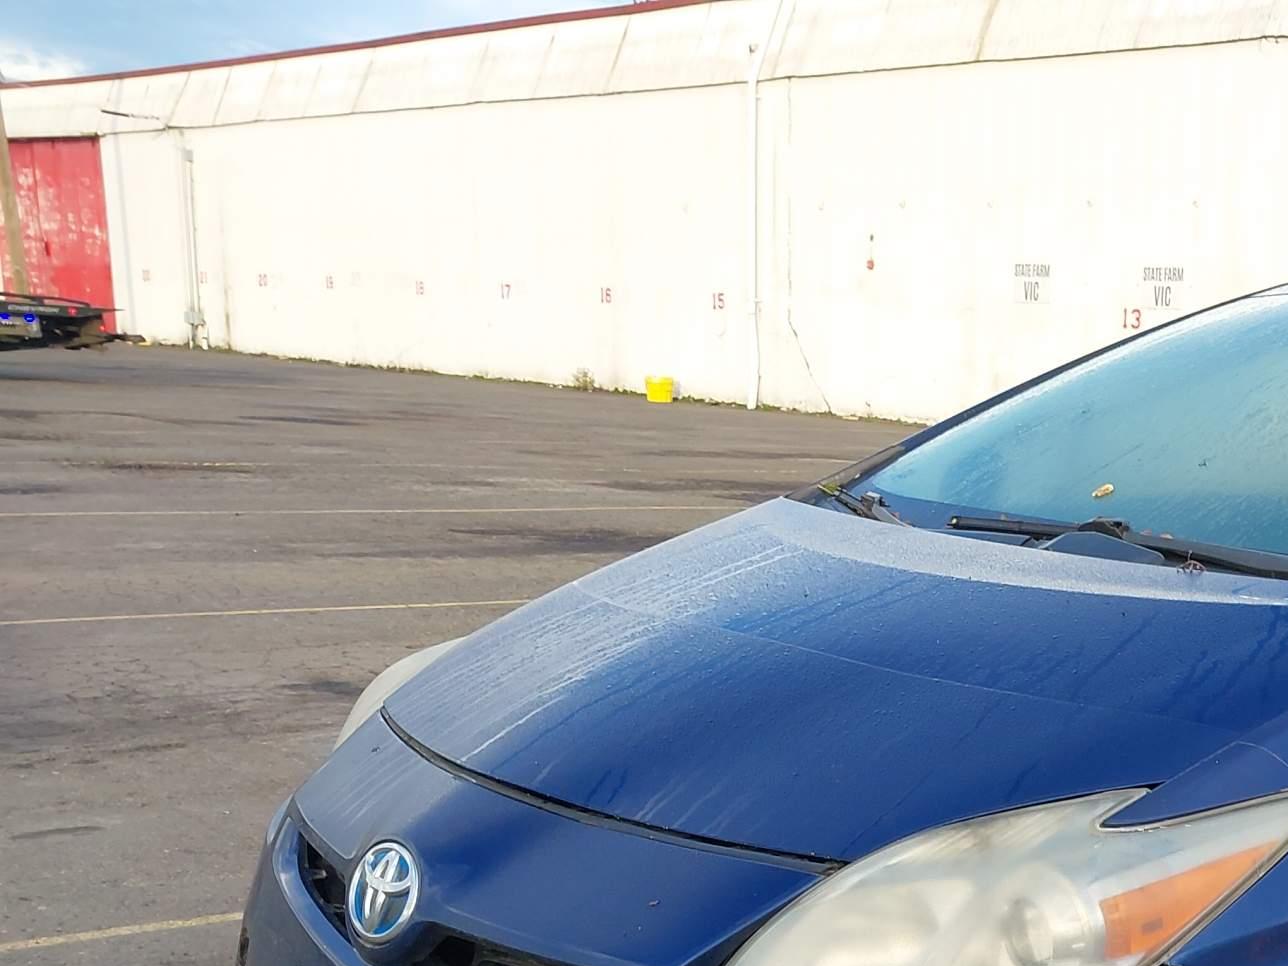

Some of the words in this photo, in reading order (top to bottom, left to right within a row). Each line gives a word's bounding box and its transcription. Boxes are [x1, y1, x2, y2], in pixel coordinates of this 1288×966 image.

[1014, 263, 1032, 277] STATE
[1033, 263, 1050, 278] FARM
[1143, 267, 1162, 281] STATE
[1164, 267, 1184, 281] FARM
[500, 282, 511, 300] 17
[600, 287, 612, 304] 16
[1023, 281, 1040, 301] VIC
[1153, 286, 1172, 306] VIC
[712, 292, 725, 310] 15
[1122, 308, 1142, 329] 13
